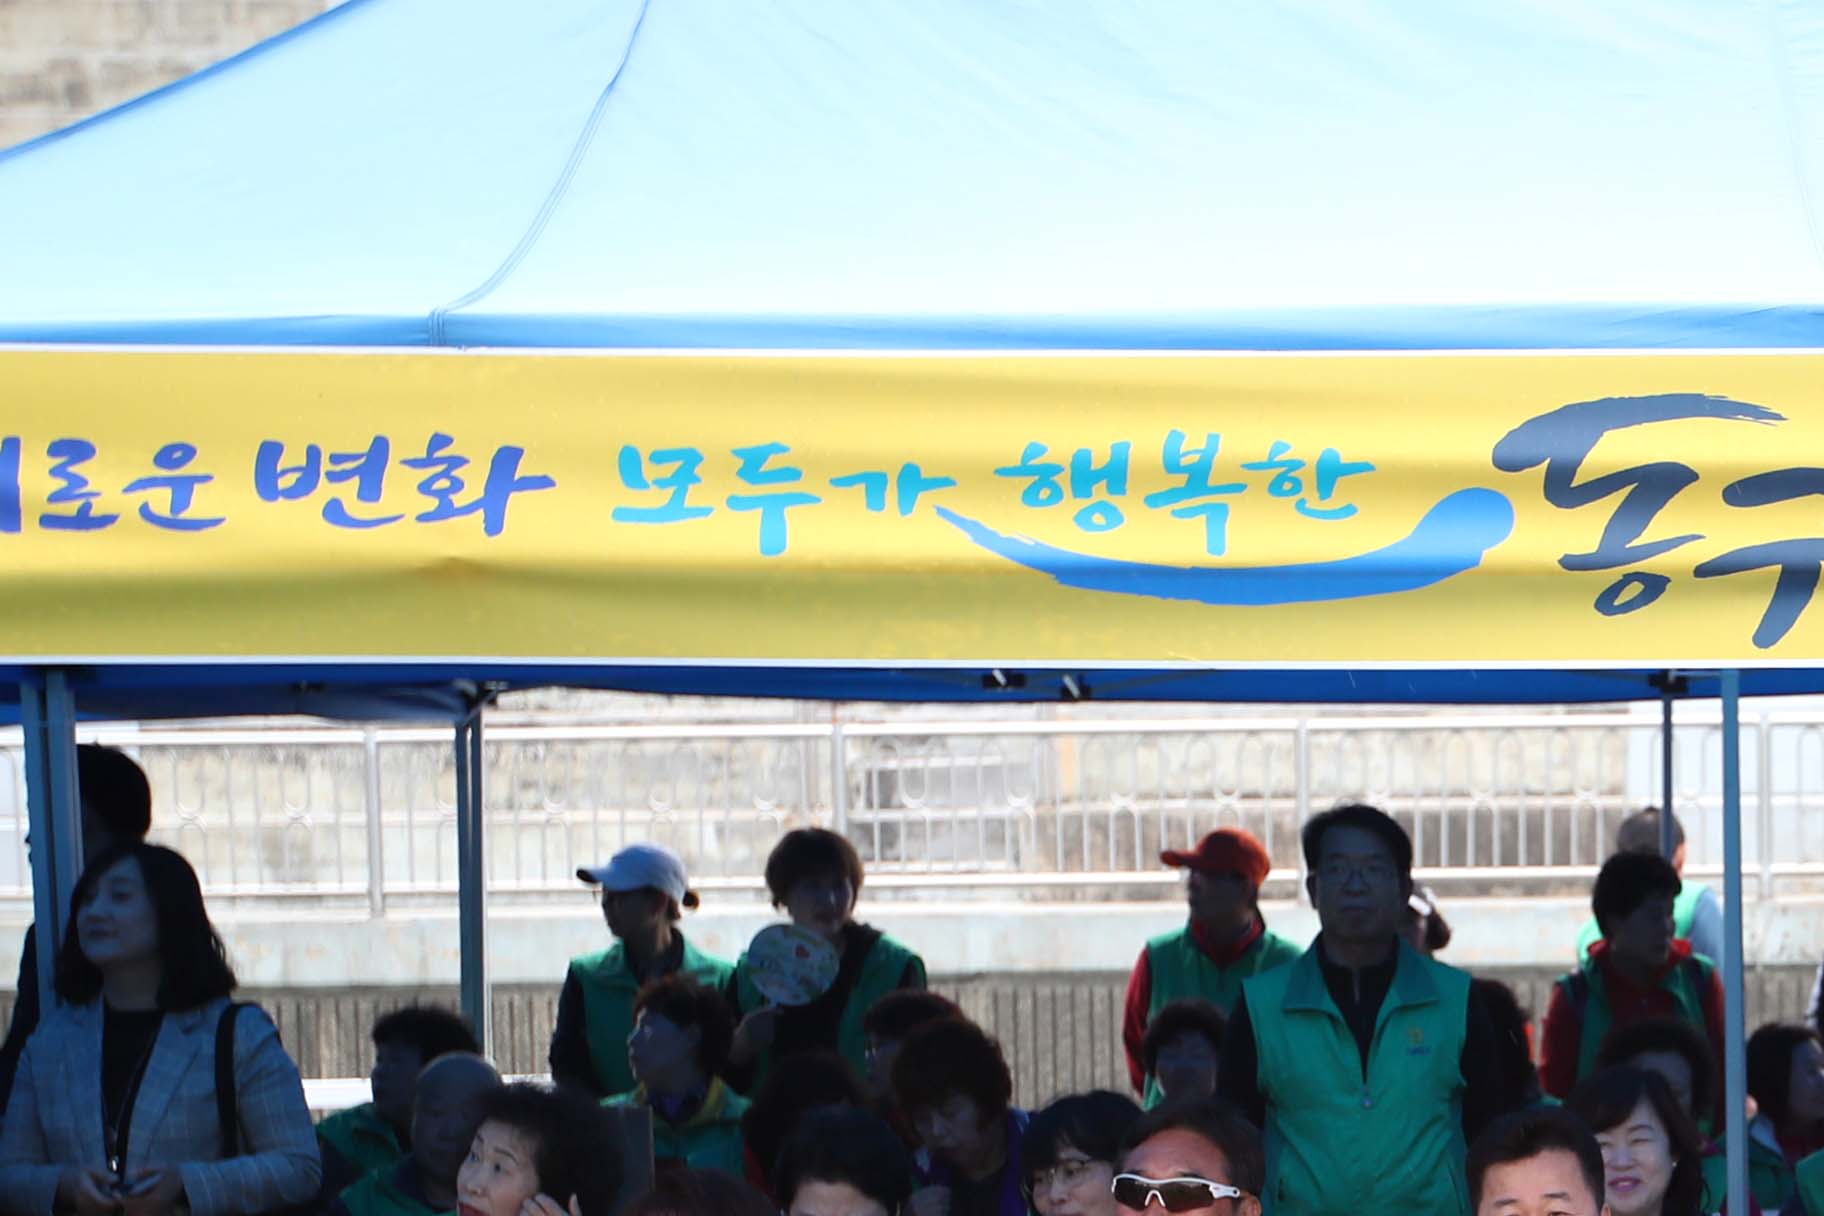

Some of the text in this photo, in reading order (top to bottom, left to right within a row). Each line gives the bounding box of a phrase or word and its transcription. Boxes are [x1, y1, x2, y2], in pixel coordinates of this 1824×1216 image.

[0, 433, 226, 533] 로운
[254, 431, 557, 537] 변화
[609, 442, 957, 556] 모두가
[993, 428, 1377, 556] 행복한
